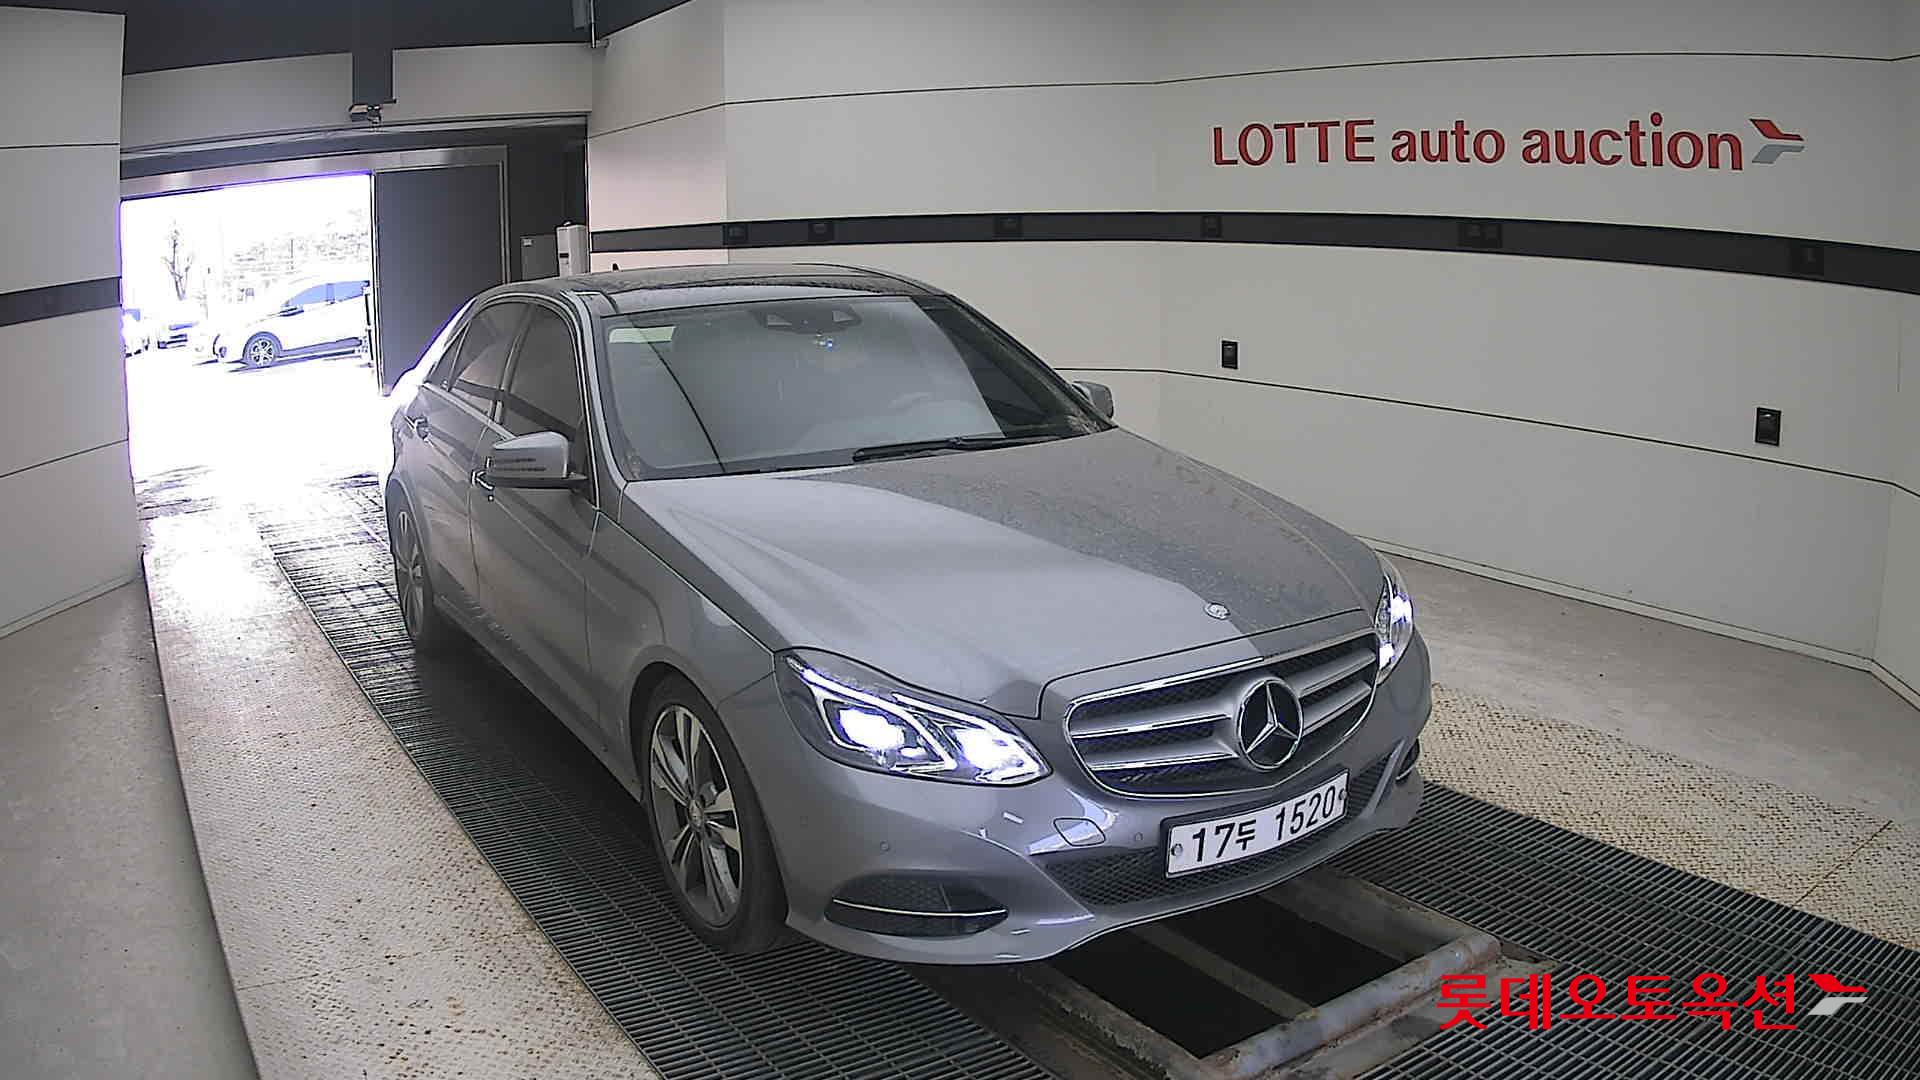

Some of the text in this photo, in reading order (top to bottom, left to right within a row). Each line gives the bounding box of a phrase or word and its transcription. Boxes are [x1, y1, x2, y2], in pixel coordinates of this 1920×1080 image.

[1213, 113, 1743, 171] LOTTE auto auction
[1191, 785, 1336, 863] 17두 1520
